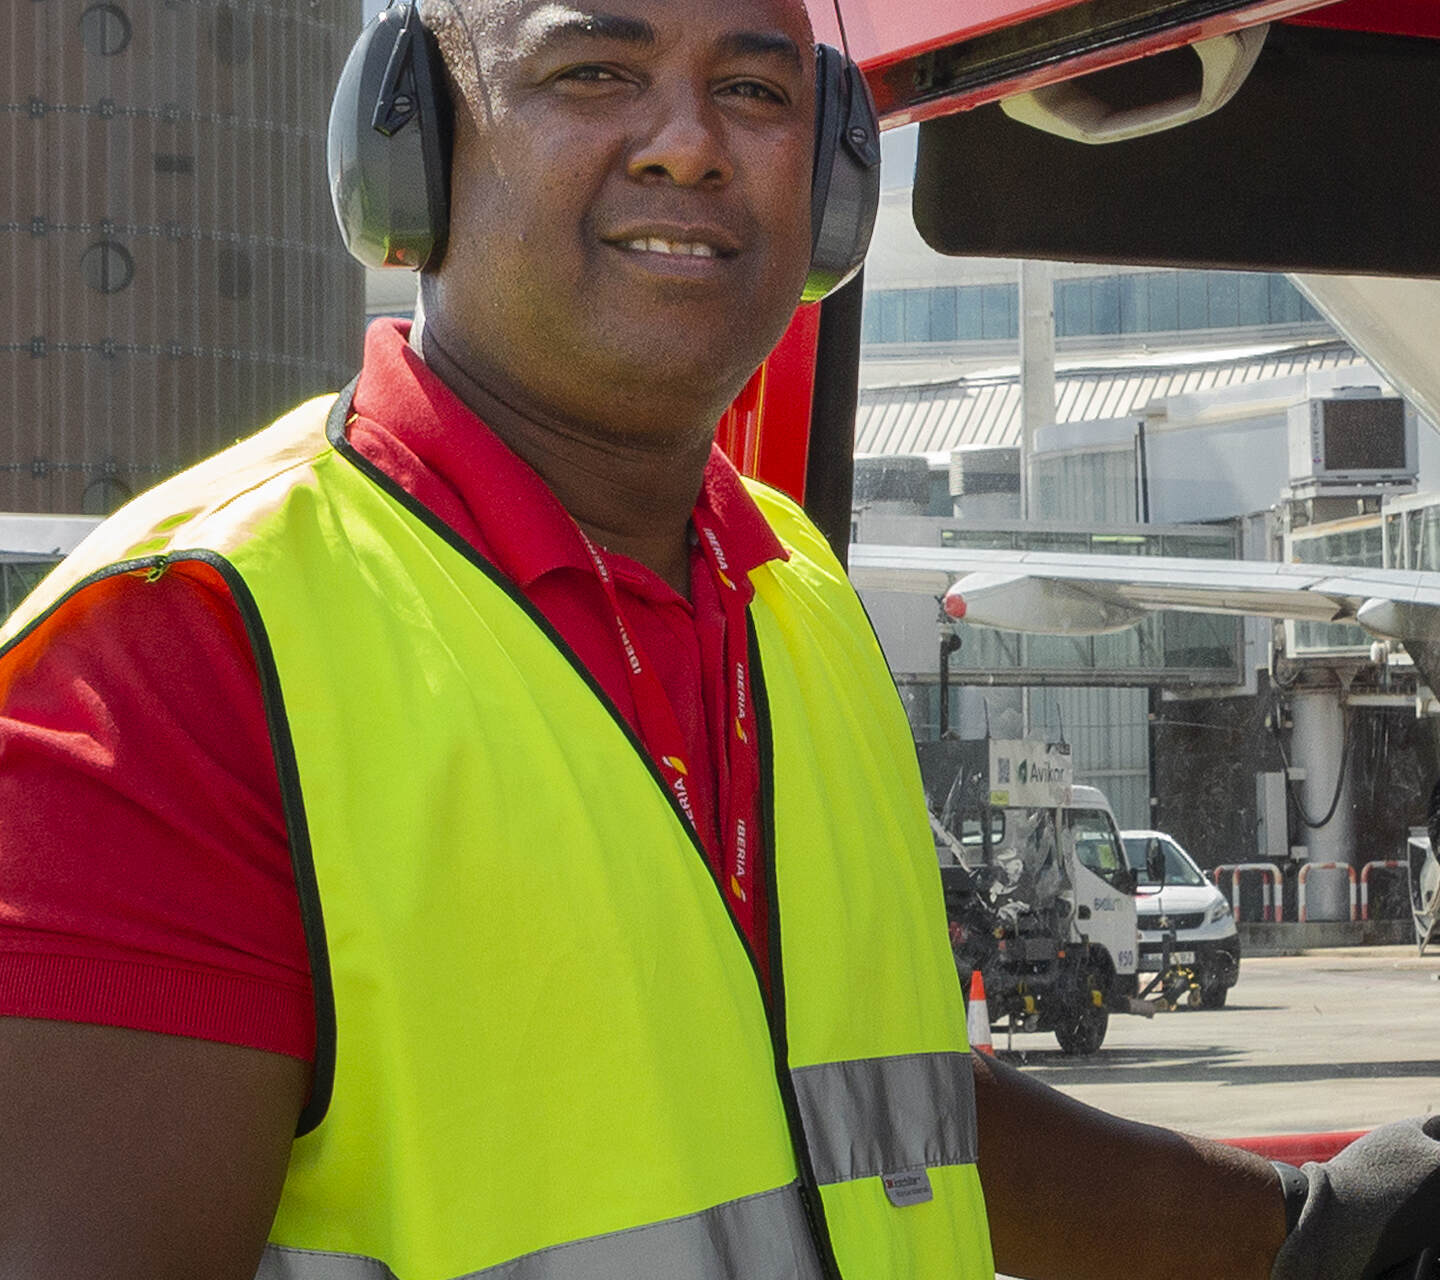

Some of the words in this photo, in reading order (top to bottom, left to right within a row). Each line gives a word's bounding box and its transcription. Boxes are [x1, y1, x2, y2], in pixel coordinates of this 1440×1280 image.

[702, 527, 728, 570] IBERIA
[735, 662, 747, 719] IBERIA
[1029, 763, 1065, 784] Avikor
[674, 777, 698, 831] ERIA
[735, 818, 746, 877] IBERIA
